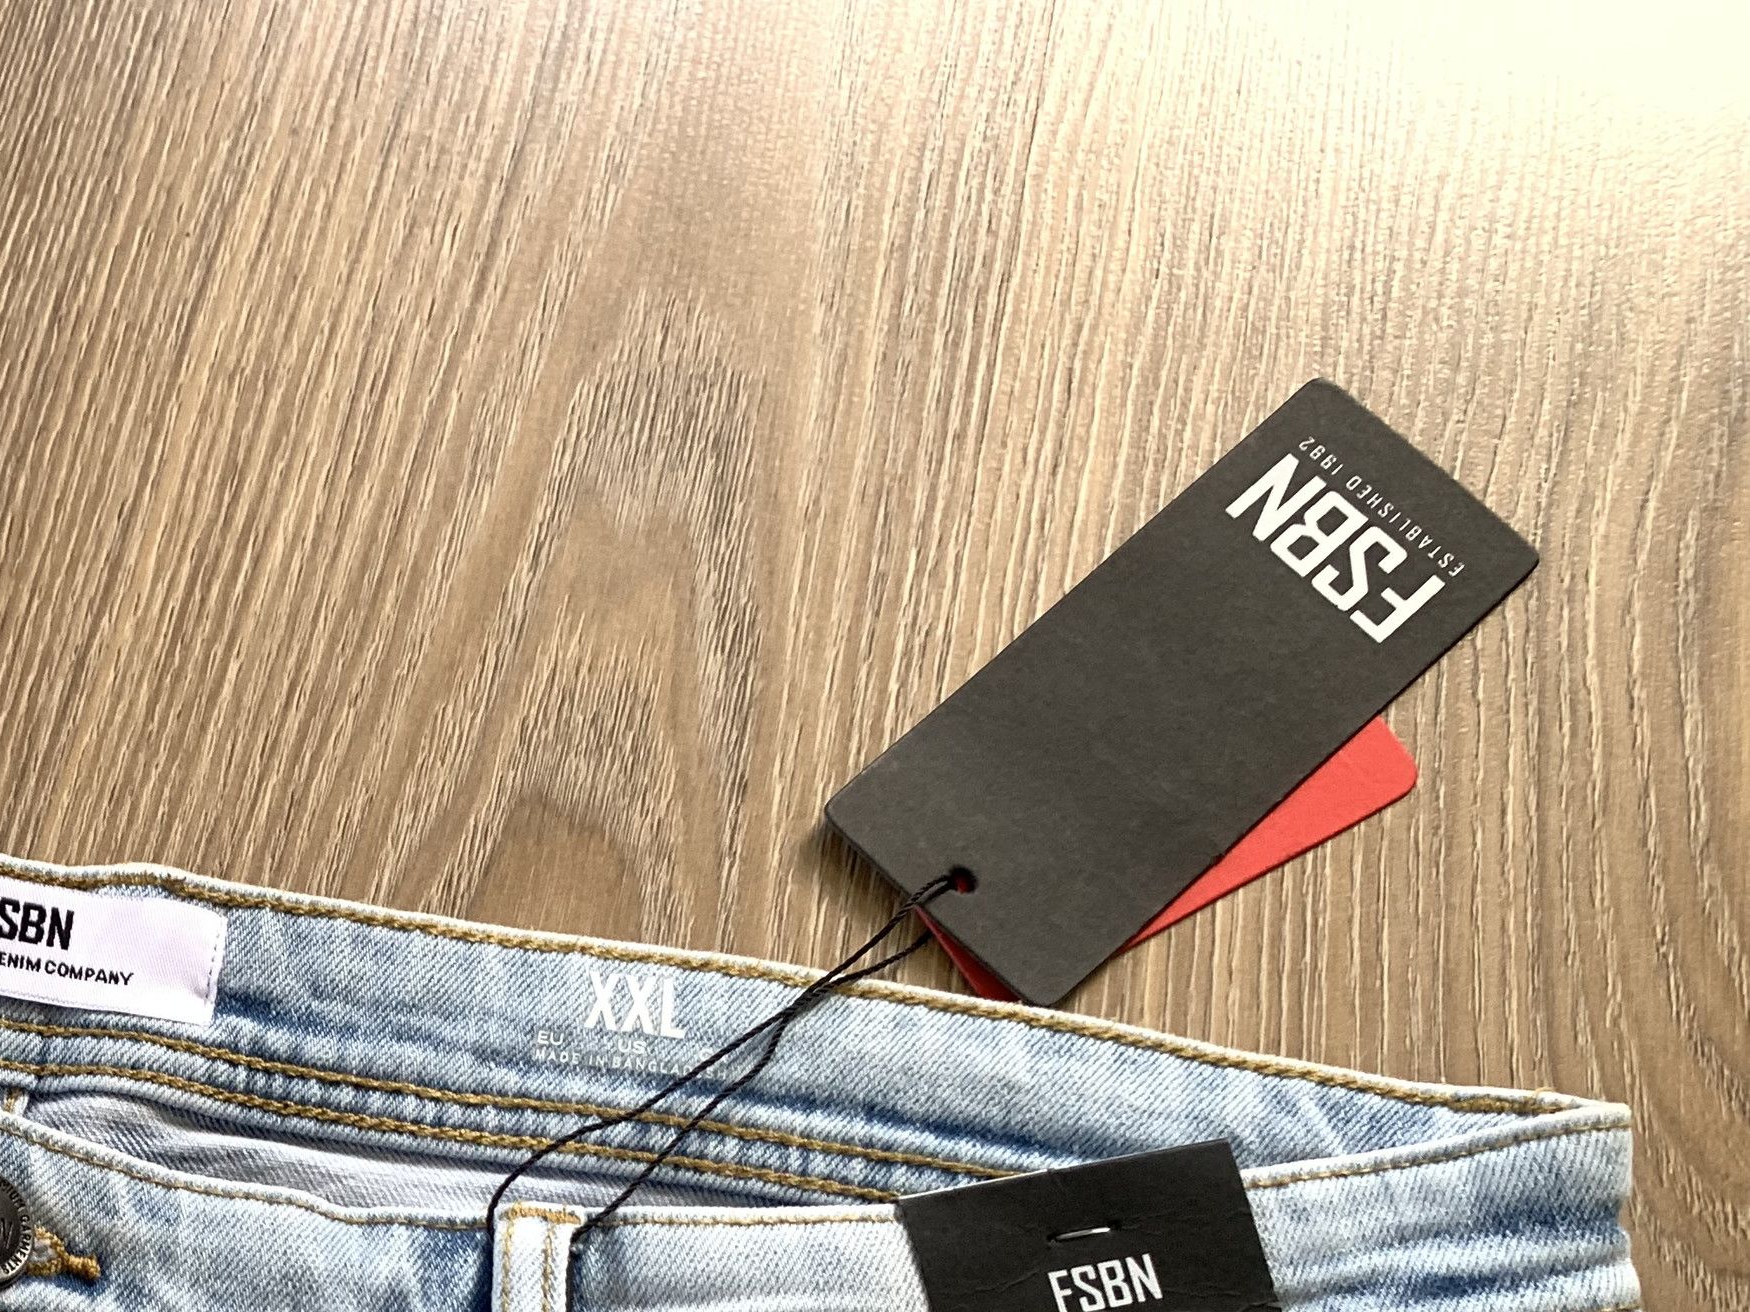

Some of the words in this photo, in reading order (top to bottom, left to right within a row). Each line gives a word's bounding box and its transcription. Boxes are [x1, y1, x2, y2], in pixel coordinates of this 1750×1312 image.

[1298, 436, 1344, 476] 1992
[1346, 475, 1466, 578] ESTABLISHED
[1225, 453, 1446, 644] FSBN
[44, 959, 133, 986] COMPANY
[584, 970, 686, 1039] XXL
[536, 1031, 565, 1047] EU
[617, 1039, 649, 1056] US
[611, 1056, 727, 1080] BANGLADSH
